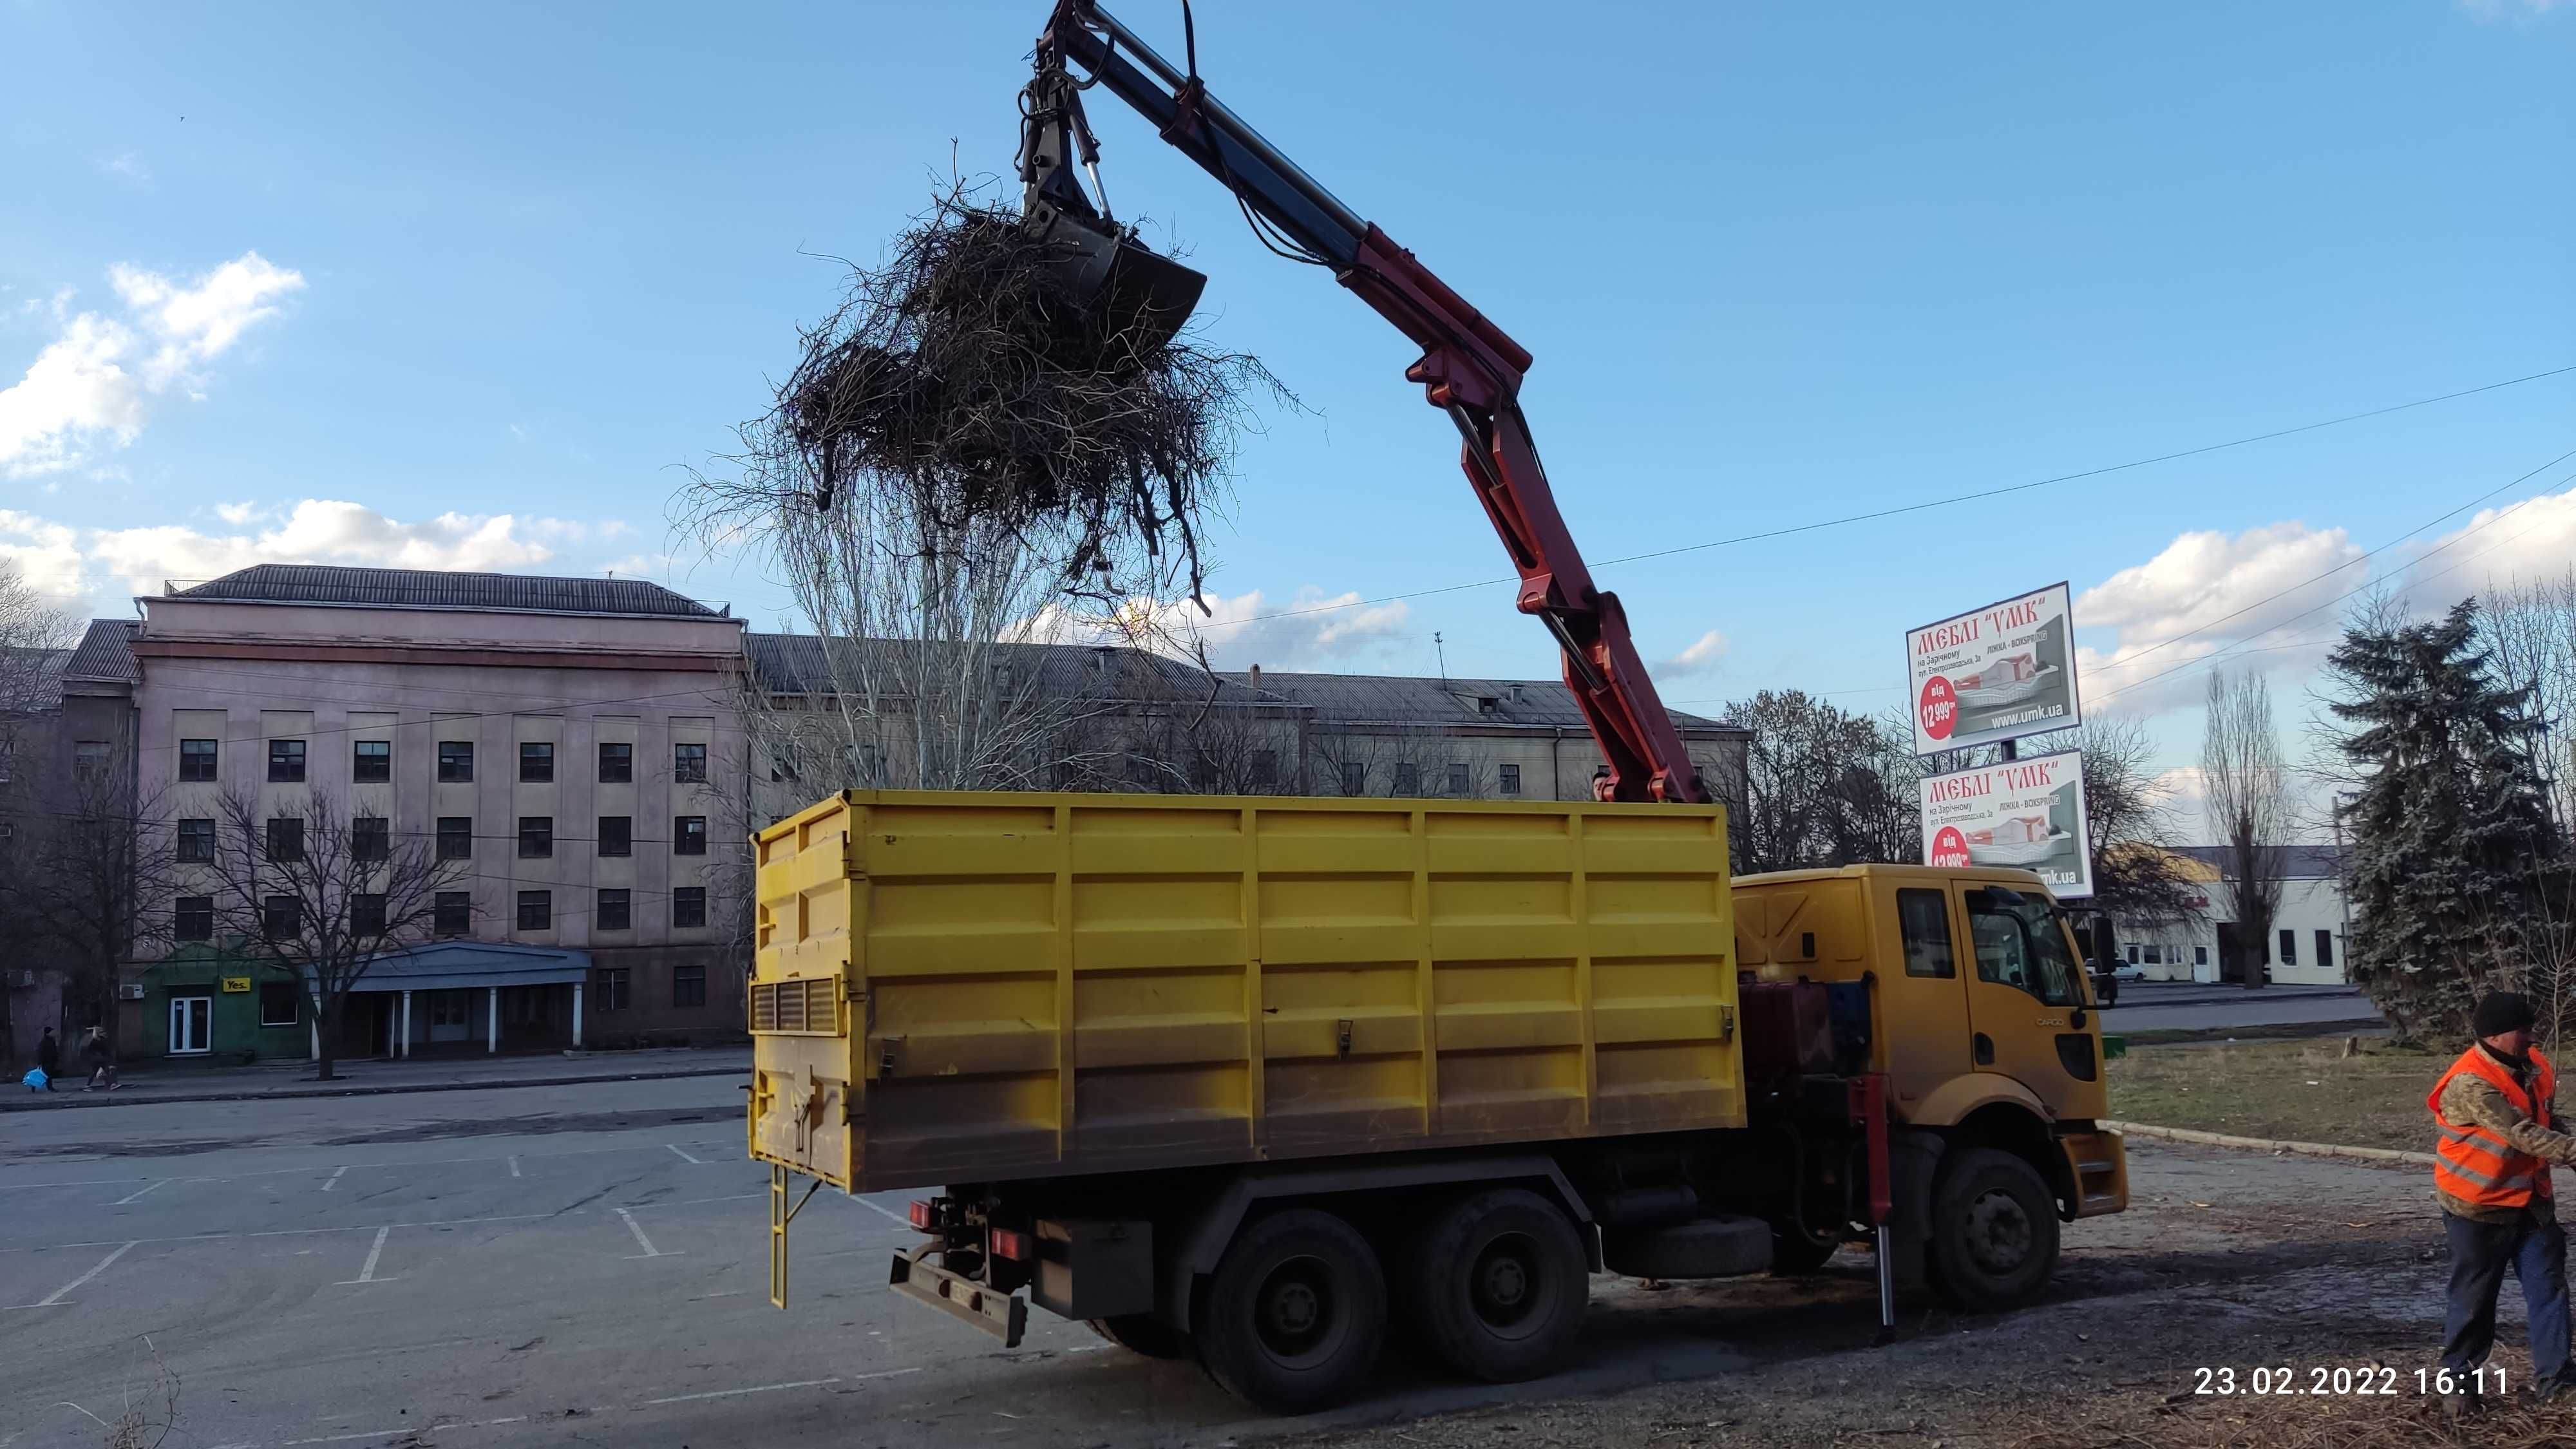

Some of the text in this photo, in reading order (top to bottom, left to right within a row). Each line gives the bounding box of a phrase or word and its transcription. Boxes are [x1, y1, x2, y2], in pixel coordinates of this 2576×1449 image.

[2012, 630, 2047, 648] BOXSPRING
[1918, 649, 1960, 668] на Зарічному
[1931, 684, 1945, 697] від
[1991, 704, 2063, 729] www.umk.ua
[1938, 802, 1972, 815] Зарічному
[2024, 795, 2060, 808] BOXSPRING
[1943, 834, 1956, 849] від
